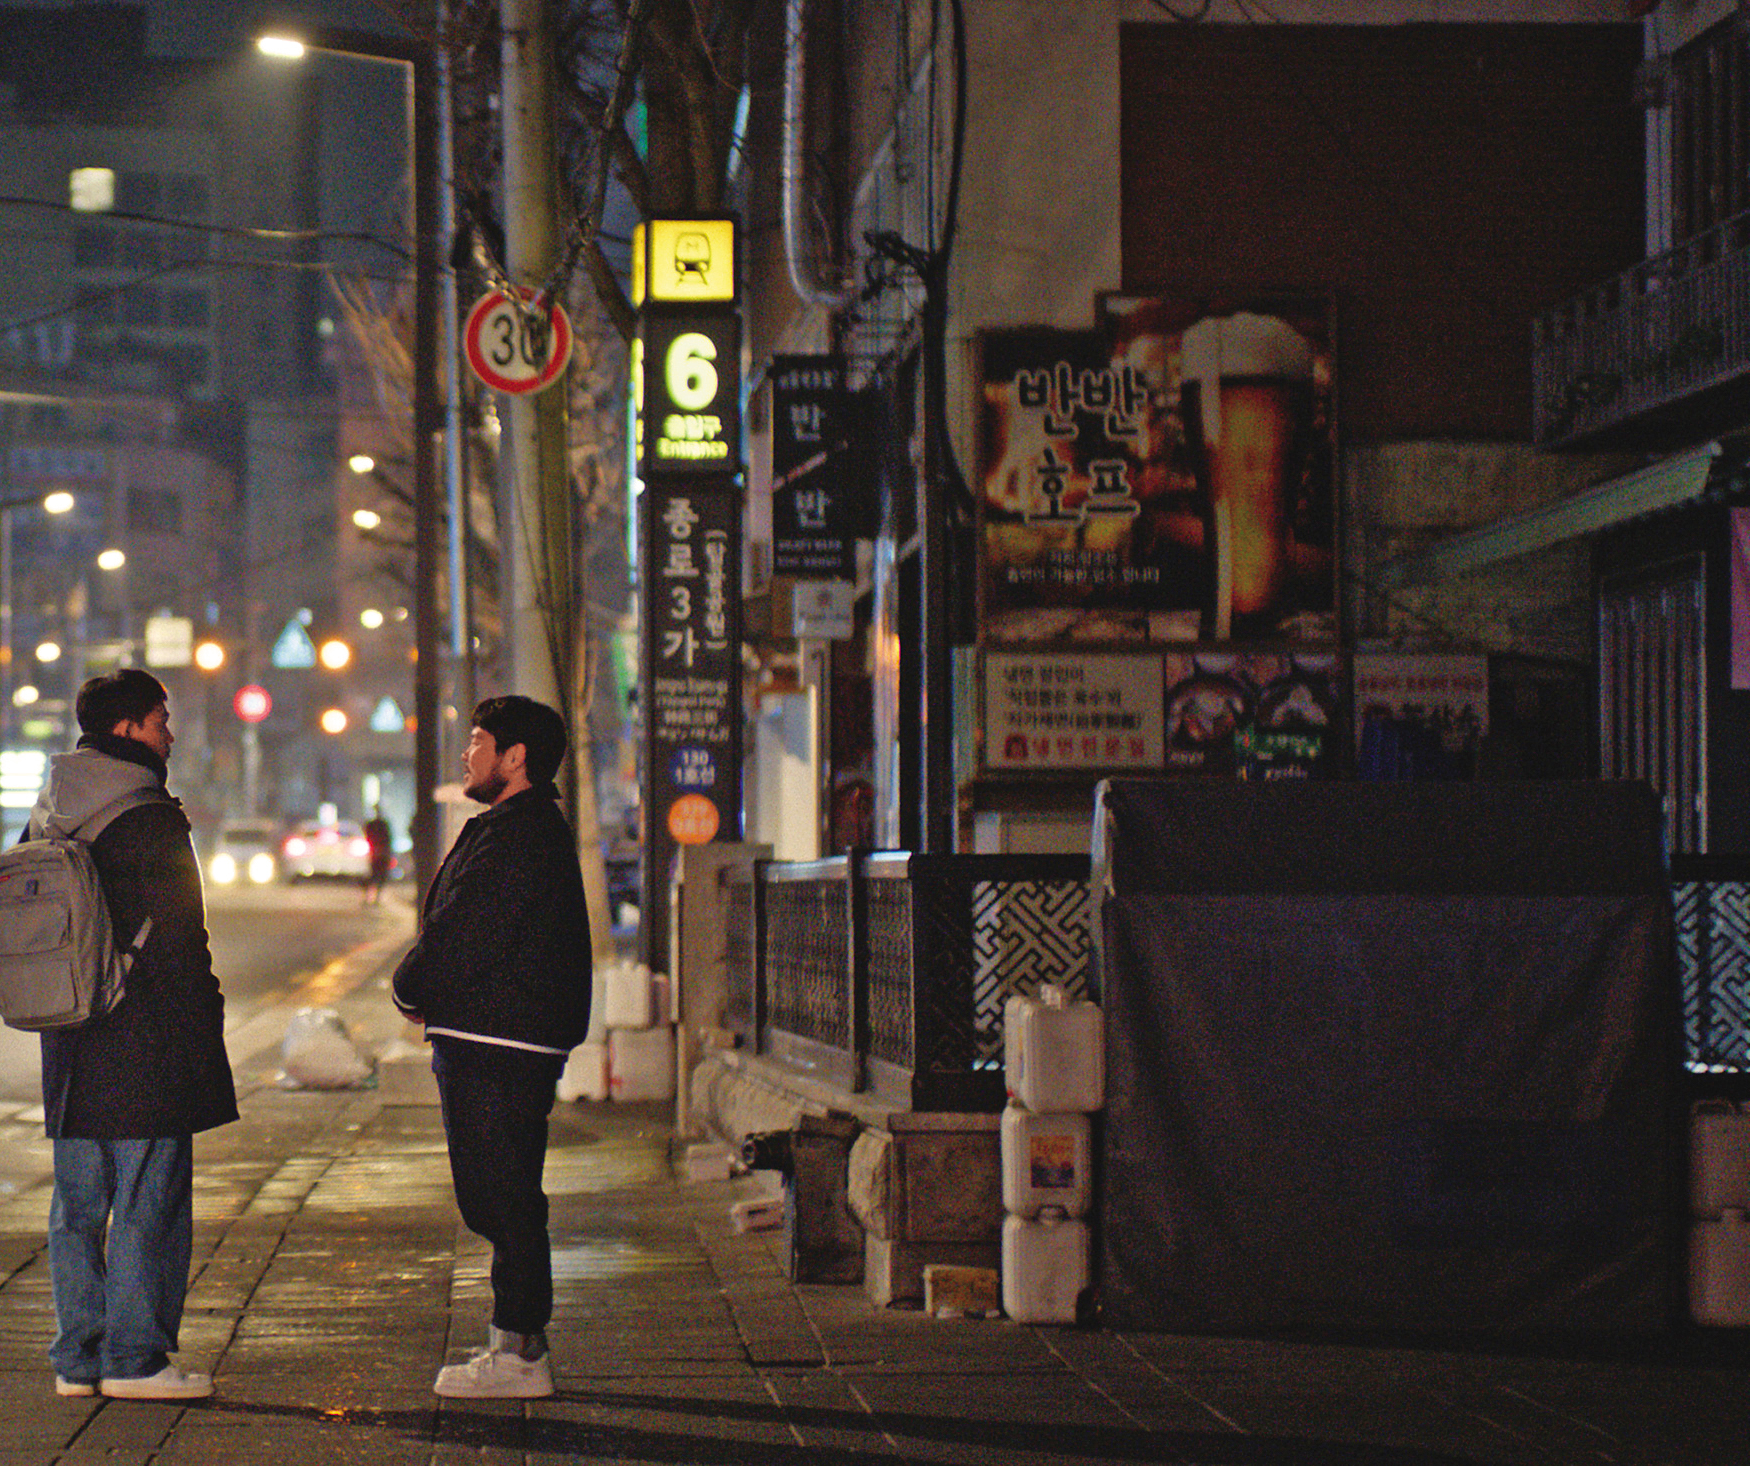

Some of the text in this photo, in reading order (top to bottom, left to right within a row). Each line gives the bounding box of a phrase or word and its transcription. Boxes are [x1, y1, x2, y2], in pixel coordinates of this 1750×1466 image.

[665, 332, 718, 411] 6
[1015, 361, 1148, 441] 반반
[1025, 446, 1142, 526] 호프
[663, 497, 699, 667] 종로3가
